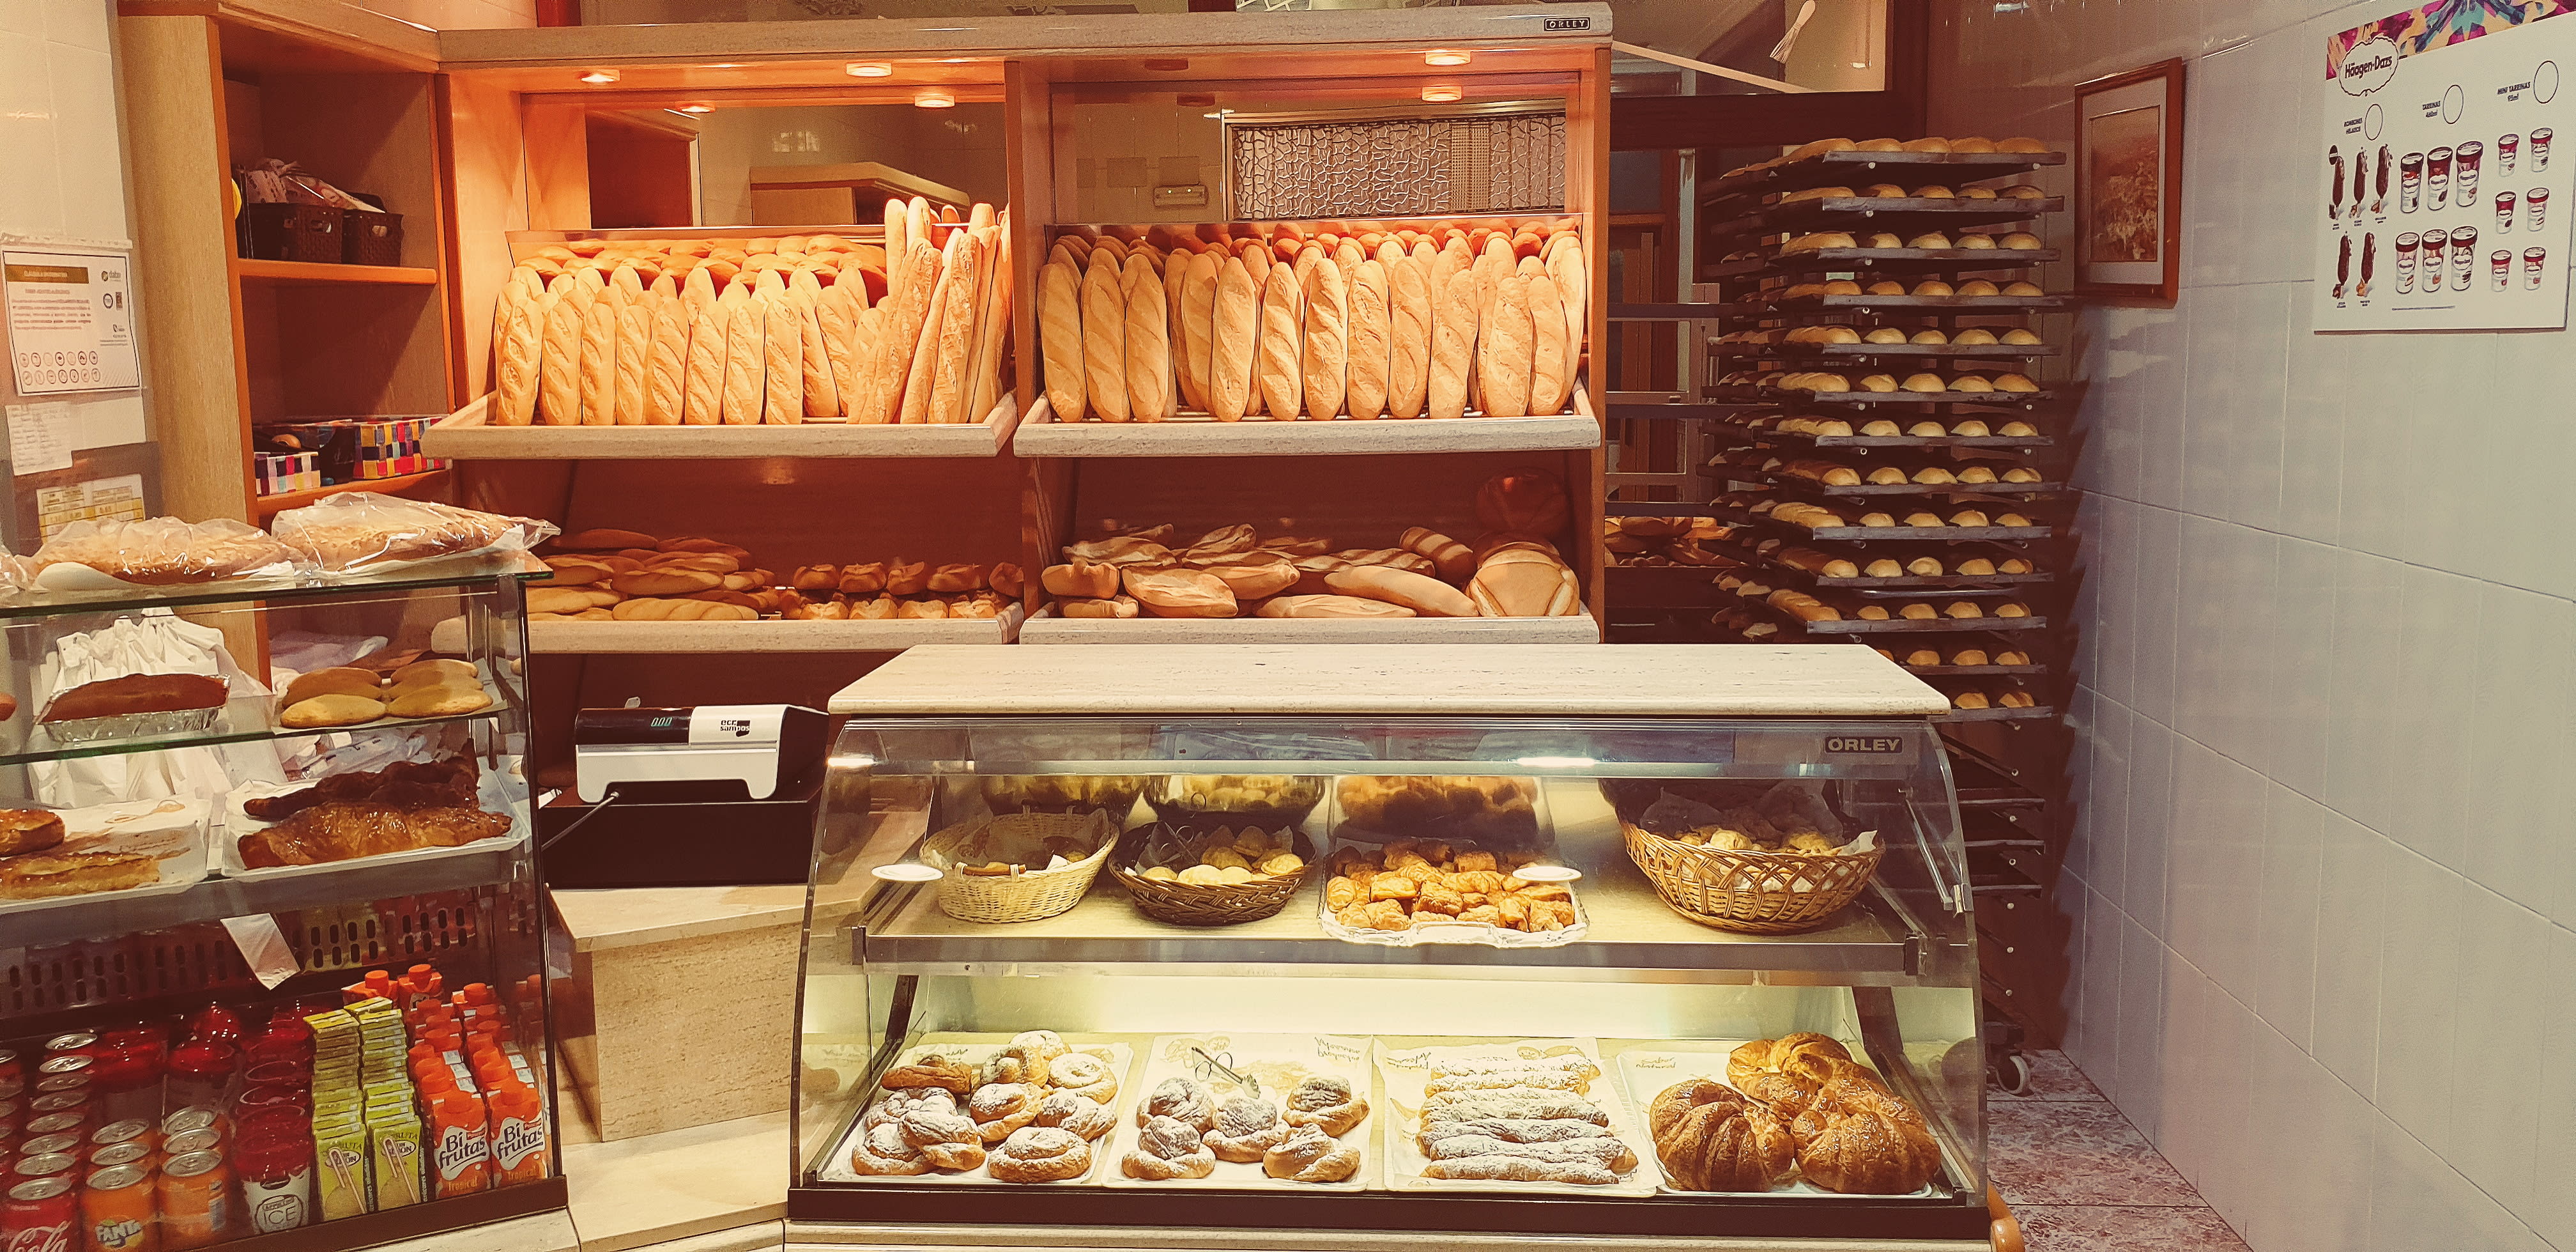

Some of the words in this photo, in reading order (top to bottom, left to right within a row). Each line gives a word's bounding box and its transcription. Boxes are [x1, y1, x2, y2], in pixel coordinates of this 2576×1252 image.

[1549, 20, 1585, 28] ORLEY
[2345, 56, 2393, 79] Häagen-Dazs
[1827, 738, 1900, 752] ORLEY
[445, 1131, 463, 1153] Bi
[496, 1126, 542, 1161] frutas
[503, 1122, 521, 1144] Bi
[439, 1136, 486, 1170] frutas
[263, 1205, 296, 1225] ICE
